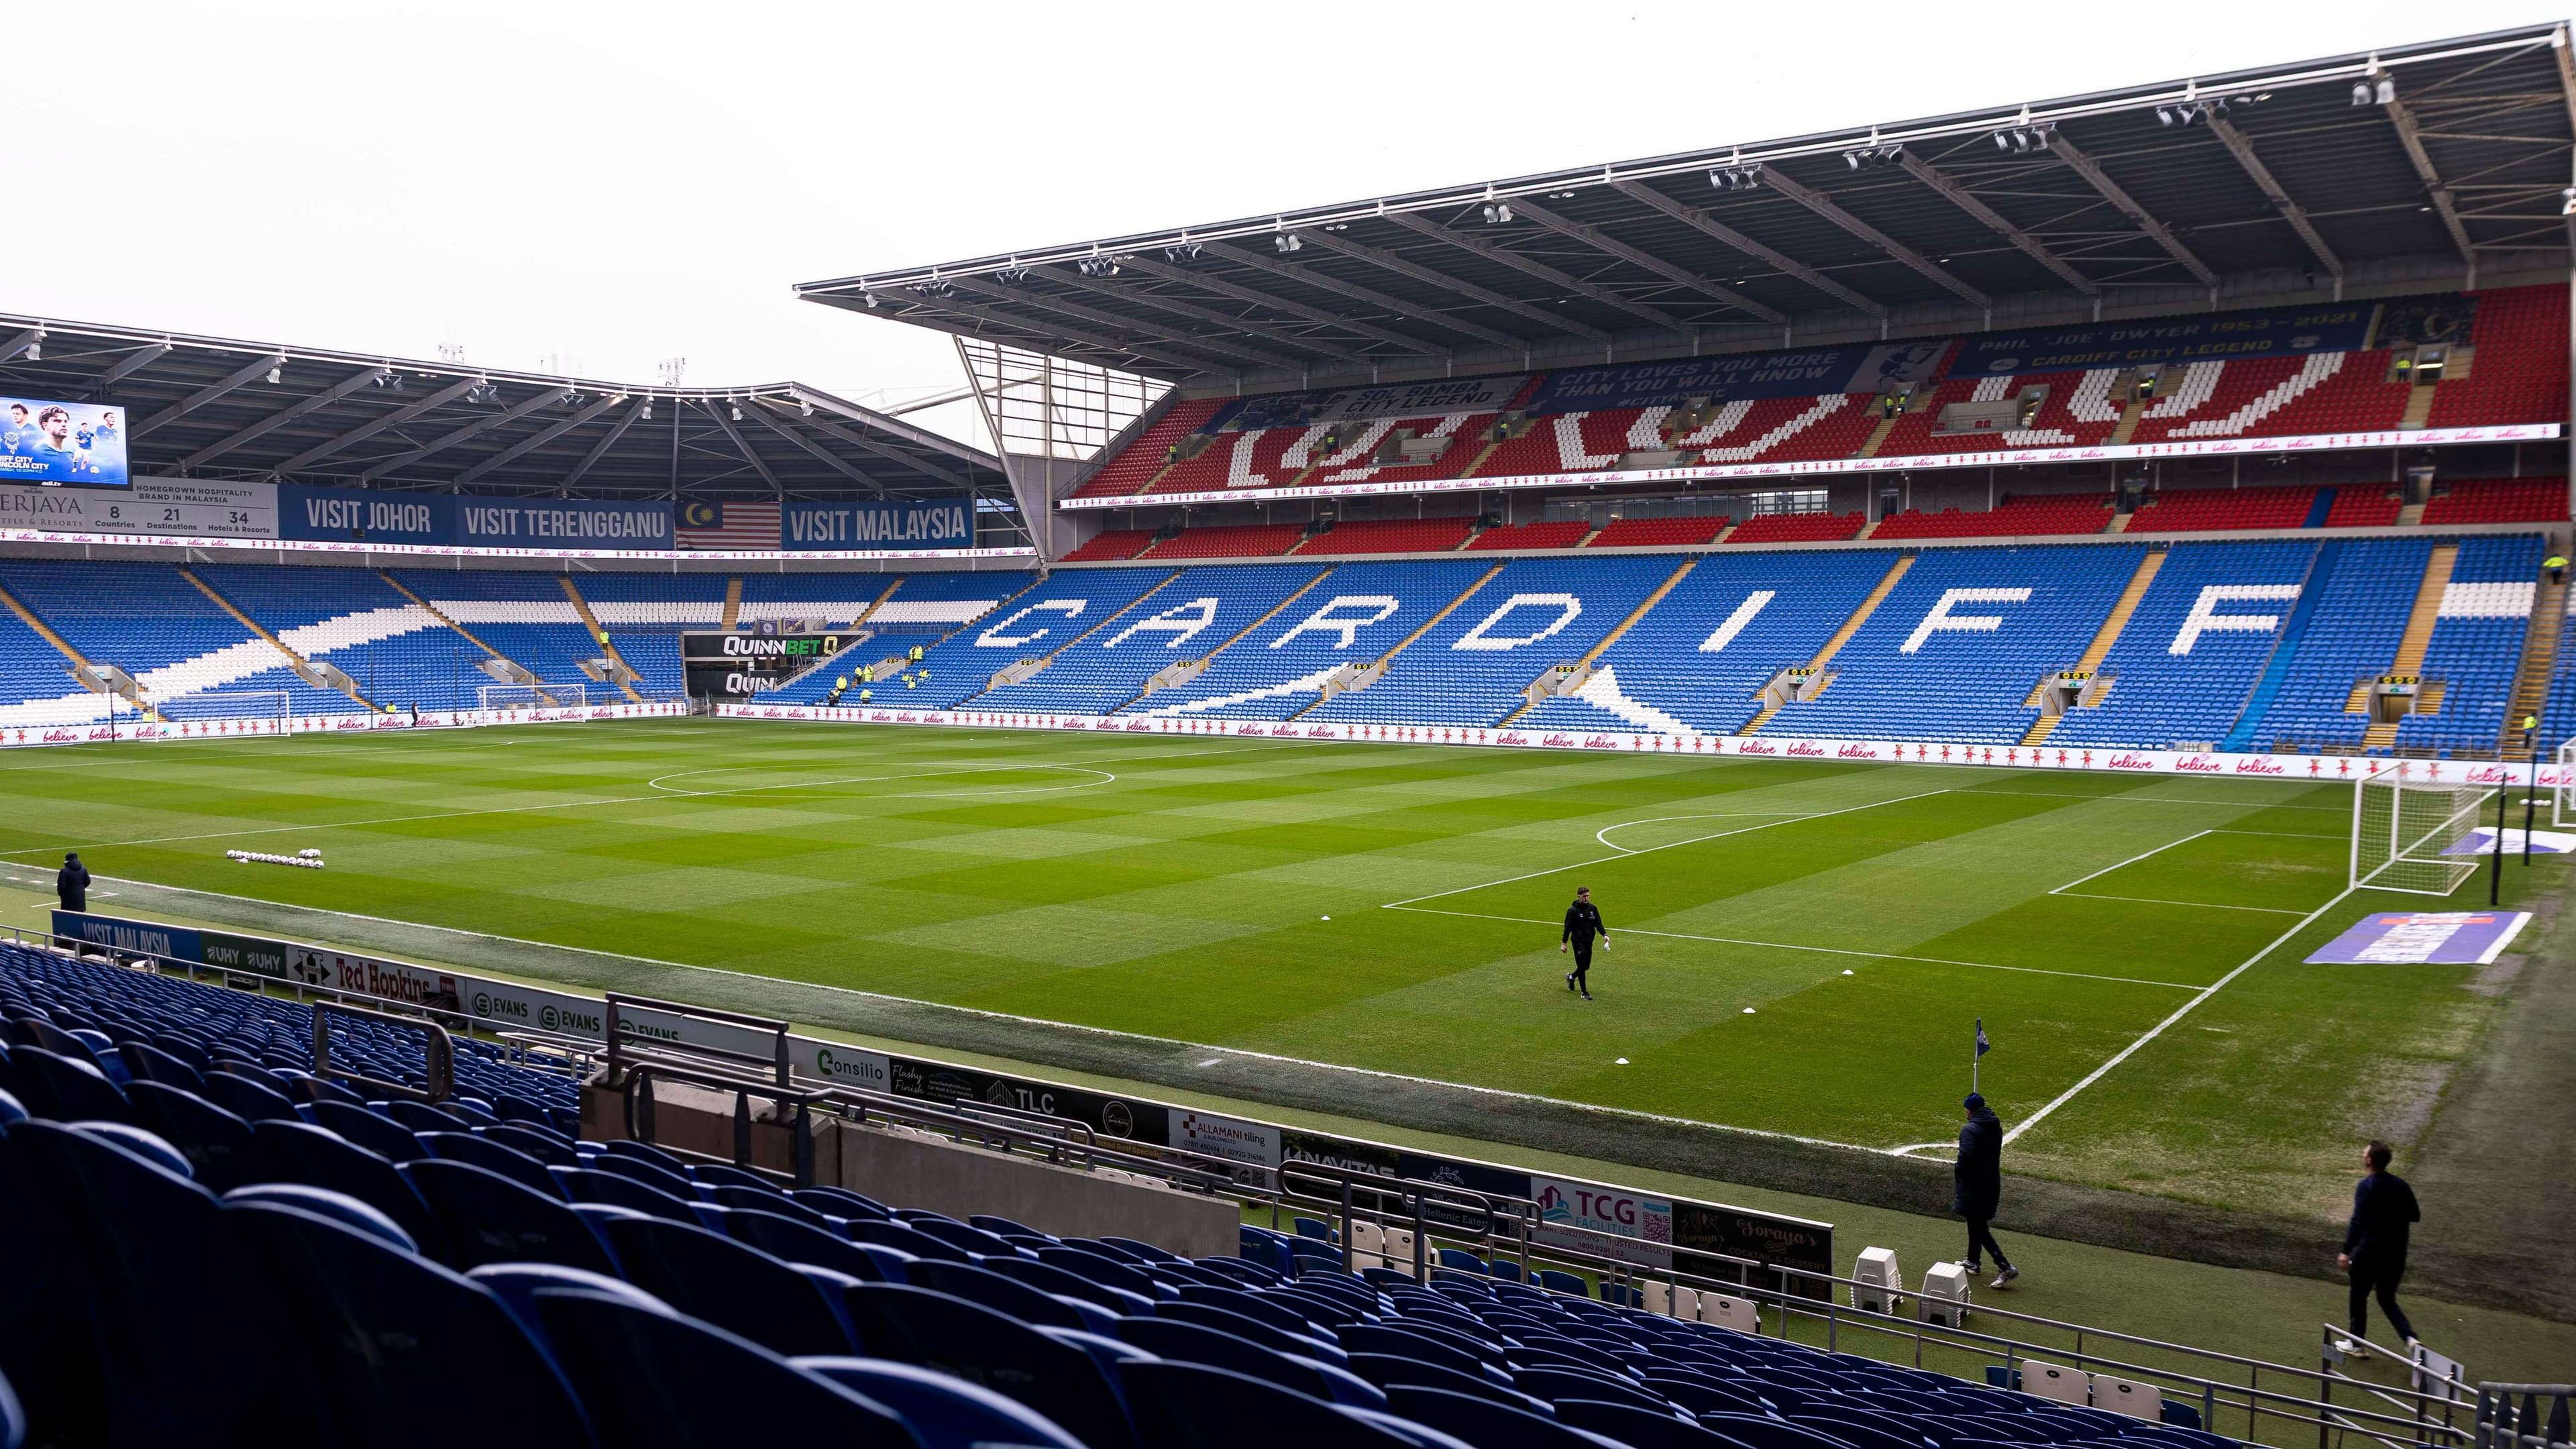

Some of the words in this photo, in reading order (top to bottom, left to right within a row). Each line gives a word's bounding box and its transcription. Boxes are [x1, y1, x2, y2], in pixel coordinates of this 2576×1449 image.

[1978, 338, 2031, 352] PHIL
[2110, 325, 2201, 342] DWYER
[2296, 311, 2359, 327] 2021
[2031, 352, 2120, 366] CARDIFF
[2125, 346, 2176, 362] CITY
[2182, 339, 2274, 356] LEGEND
[1559, 370, 1616, 386] CITY
[1620, 364, 1701, 380] LOVES
[1710, 358, 1762, 373] YOU
[1766, 352, 1842, 368] MORE
[1357, 388, 1397, 401] SOL
[1405, 382, 1483, 397] BAMBA
[1554, 382, 1613, 397] THAN
[1621, 378, 1670, 392] YOU
[1678, 373, 1739, 387] WILL
[1750, 366, 1830, 382] KNOW
[1345, 398, 1398, 413] CITY
[1401, 392, 1495, 409] LEGEND
[137, 485, 195, 494] HOMEGROWN
[199, 488, 254, 497] HOSPITALITY
[110, 506, 119, 519] 8
[164, 508, 179, 521] 21
[229, 511, 248, 524] 34
[306, 498, 362, 529] VISIT
[367, 502, 431, 533] JOHOR
[466, 507, 519, 535] VISIT
[525, 510, 665, 538] TERENGGANU
[791, 511, 849, 541] VISIT
[857, 506, 966, 541] MALAYSIA
[95, 521, 136, 529] Countries
[147, 522, 197, 531] Destinations
[974, 584, 2302, 657] CARDIFF
[723, 636, 820, 656] QUINNBET
[726, 673, 777, 694] QUIN
[337, 719, 366, 729] believe
[378, 718, 405, 727] believe
[415, 716, 440, 726] elieve
[559, 711, 584, 719] believe
[871, 713, 892, 721] believe
[1063, 720, 1086, 728] believe
[1096, 721, 1120, 729] believe
[1126, 721, 1150, 730] believe
[43, 731, 78, 741] believe
[89, 729, 123, 740] believe
[1238, 725, 1265, 735] believe
[1272, 727, 1299, 736] believe
[1308, 728, 1335, 737] believe
[1497, 734, 1527, 745] believe
[1543, 735, 1574, 747] believe
[1585, 737, 1617, 748] believe
[1739, 741, 1776, 754] believe
[1786, 743, 1825, 755] believe
[1838, 745, 1877, 758] believe
[2108, 755, 2153, 769] believe
[2175, 757, 2222, 771] believe
[2236, 759, 2285, 773] believe
[83, 922, 111, 945] VISIT
[114, 926, 172, 957] MALAYSIA
[216, 947, 239, 965] UHY
[256, 953, 280, 971] UHY
[336, 958, 365, 991] Ted
[368, 963, 430, 1002] Hopkins
[494, 998, 527, 1018] EVANS
[562, 1011, 600, 1032] EVANS
[817, 1049, 883, 1079] Consilio
[892, 1065, 924, 1083] Flashy
[895, 1079, 924, 1094] Finish
[1017, 1088, 1056, 1115] TLC
[1073, 1134, 1085, 1143] Flat
[1095, 1138, 1116, 1150] itched
[1117, 1142, 1131, 1154] Roof
[1197, 1122, 1242, 1139] ALLAMANI
[1244, 1132, 1265, 1147] tiling
[1208, 1135, 1228, 1143] BUILDING
[1183, 1139, 1198, 1148] 07811
[1200, 1144, 1220, 1152] 450614
[1228, 1148, 1246, 1158] 02920
[1248, 1152, 1266, 1162] 316186
[1424, 1207, 1459, 1224] Hellenic
[1462, 1214, 1489, 1229] Eater
[1576, 1190, 1635, 1225] TCG
[1576, 1217, 1635, 1237] FACILITIES
[1736, 1218, 1815, 1246] Soraya's
[1560, 1230, 1599, 1242] SOLUTIONS
[1605, 1237, 1638, 1250] TUSTED
[1640, 1245, 1670, 1256] RESULTS
[1578, 1242, 1594, 1250] 0800
[1728, 1246, 1773, 1262] COCKTAIL
[1784, 1257, 1826, 1271] DESSERT
